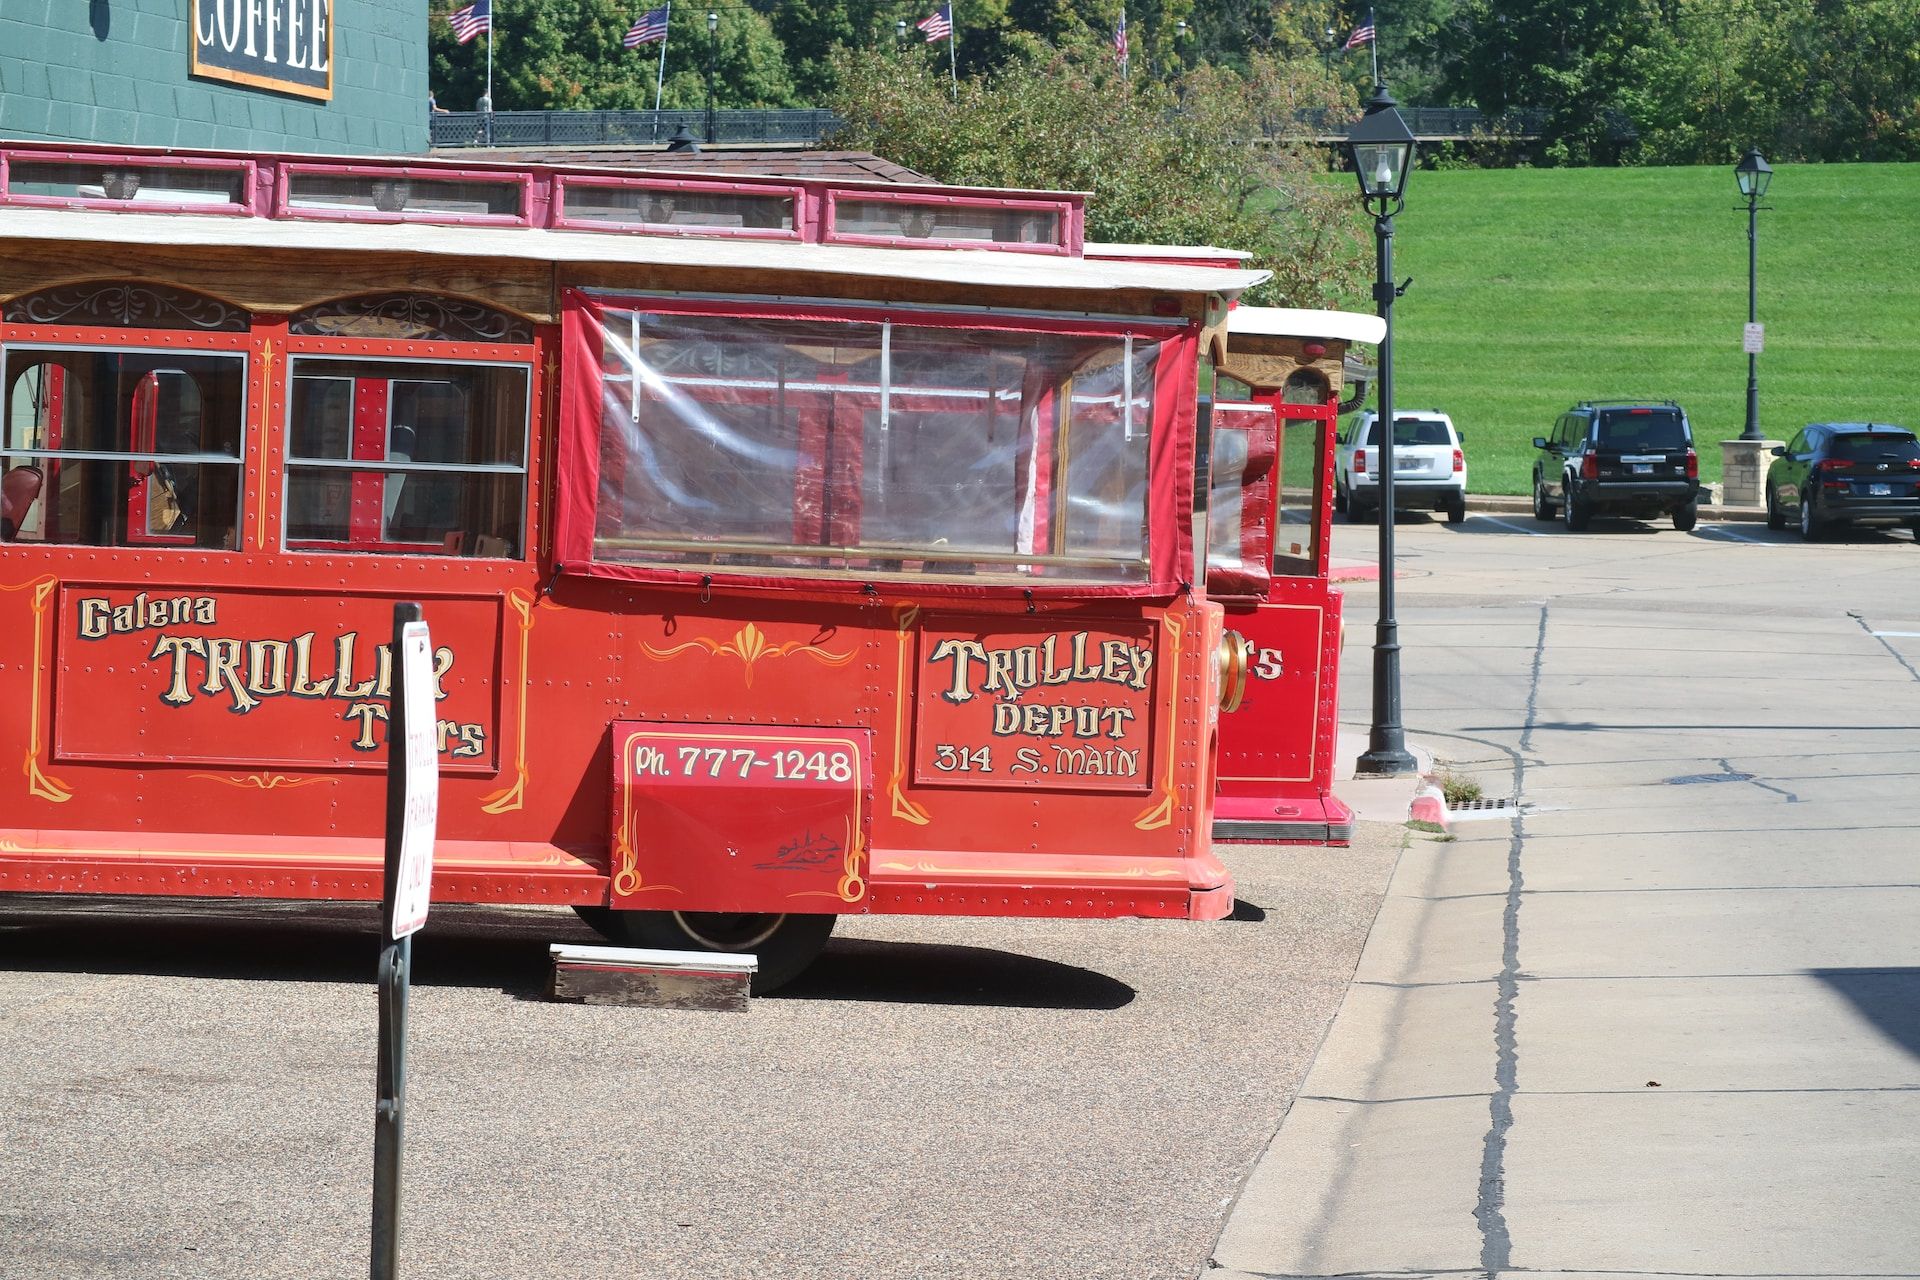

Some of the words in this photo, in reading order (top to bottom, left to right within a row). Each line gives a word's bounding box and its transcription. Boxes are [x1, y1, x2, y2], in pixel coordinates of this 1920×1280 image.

[196, 0, 328, 72] COFFEE
[78, 592, 217, 639] Galena
[929, 631, 1153, 703] TROLLEY
[344, 702, 486, 757] Trs
[994, 702, 1135, 738] DEPOT
[635, 746, 670, 776] Ph.
[678, 746, 852, 782] 777-1248
[934, 744, 992, 772] 314
[1010, 747, 1049, 775] S.
[1050, 744, 1140, 777] MAIN
